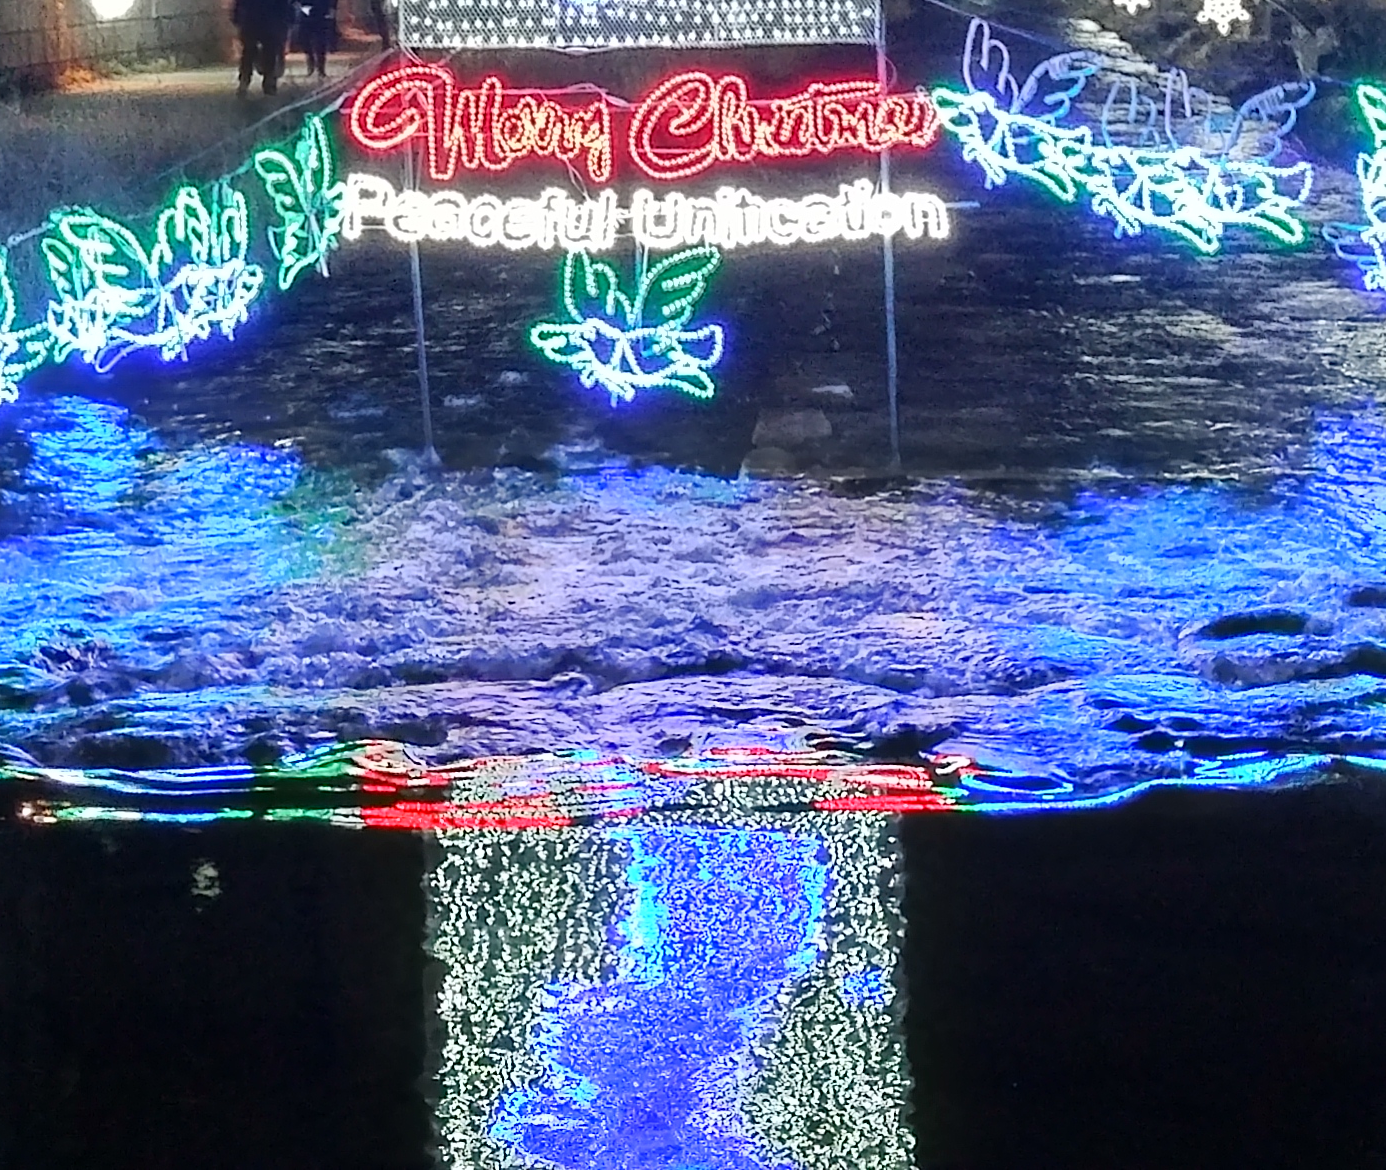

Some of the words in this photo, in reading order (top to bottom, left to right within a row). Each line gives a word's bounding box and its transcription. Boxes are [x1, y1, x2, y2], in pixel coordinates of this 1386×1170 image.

[350, 66, 613, 183] Merry
[342, 172, 617, 251] Peaceful
[631, 178, 949, 249] Unification
